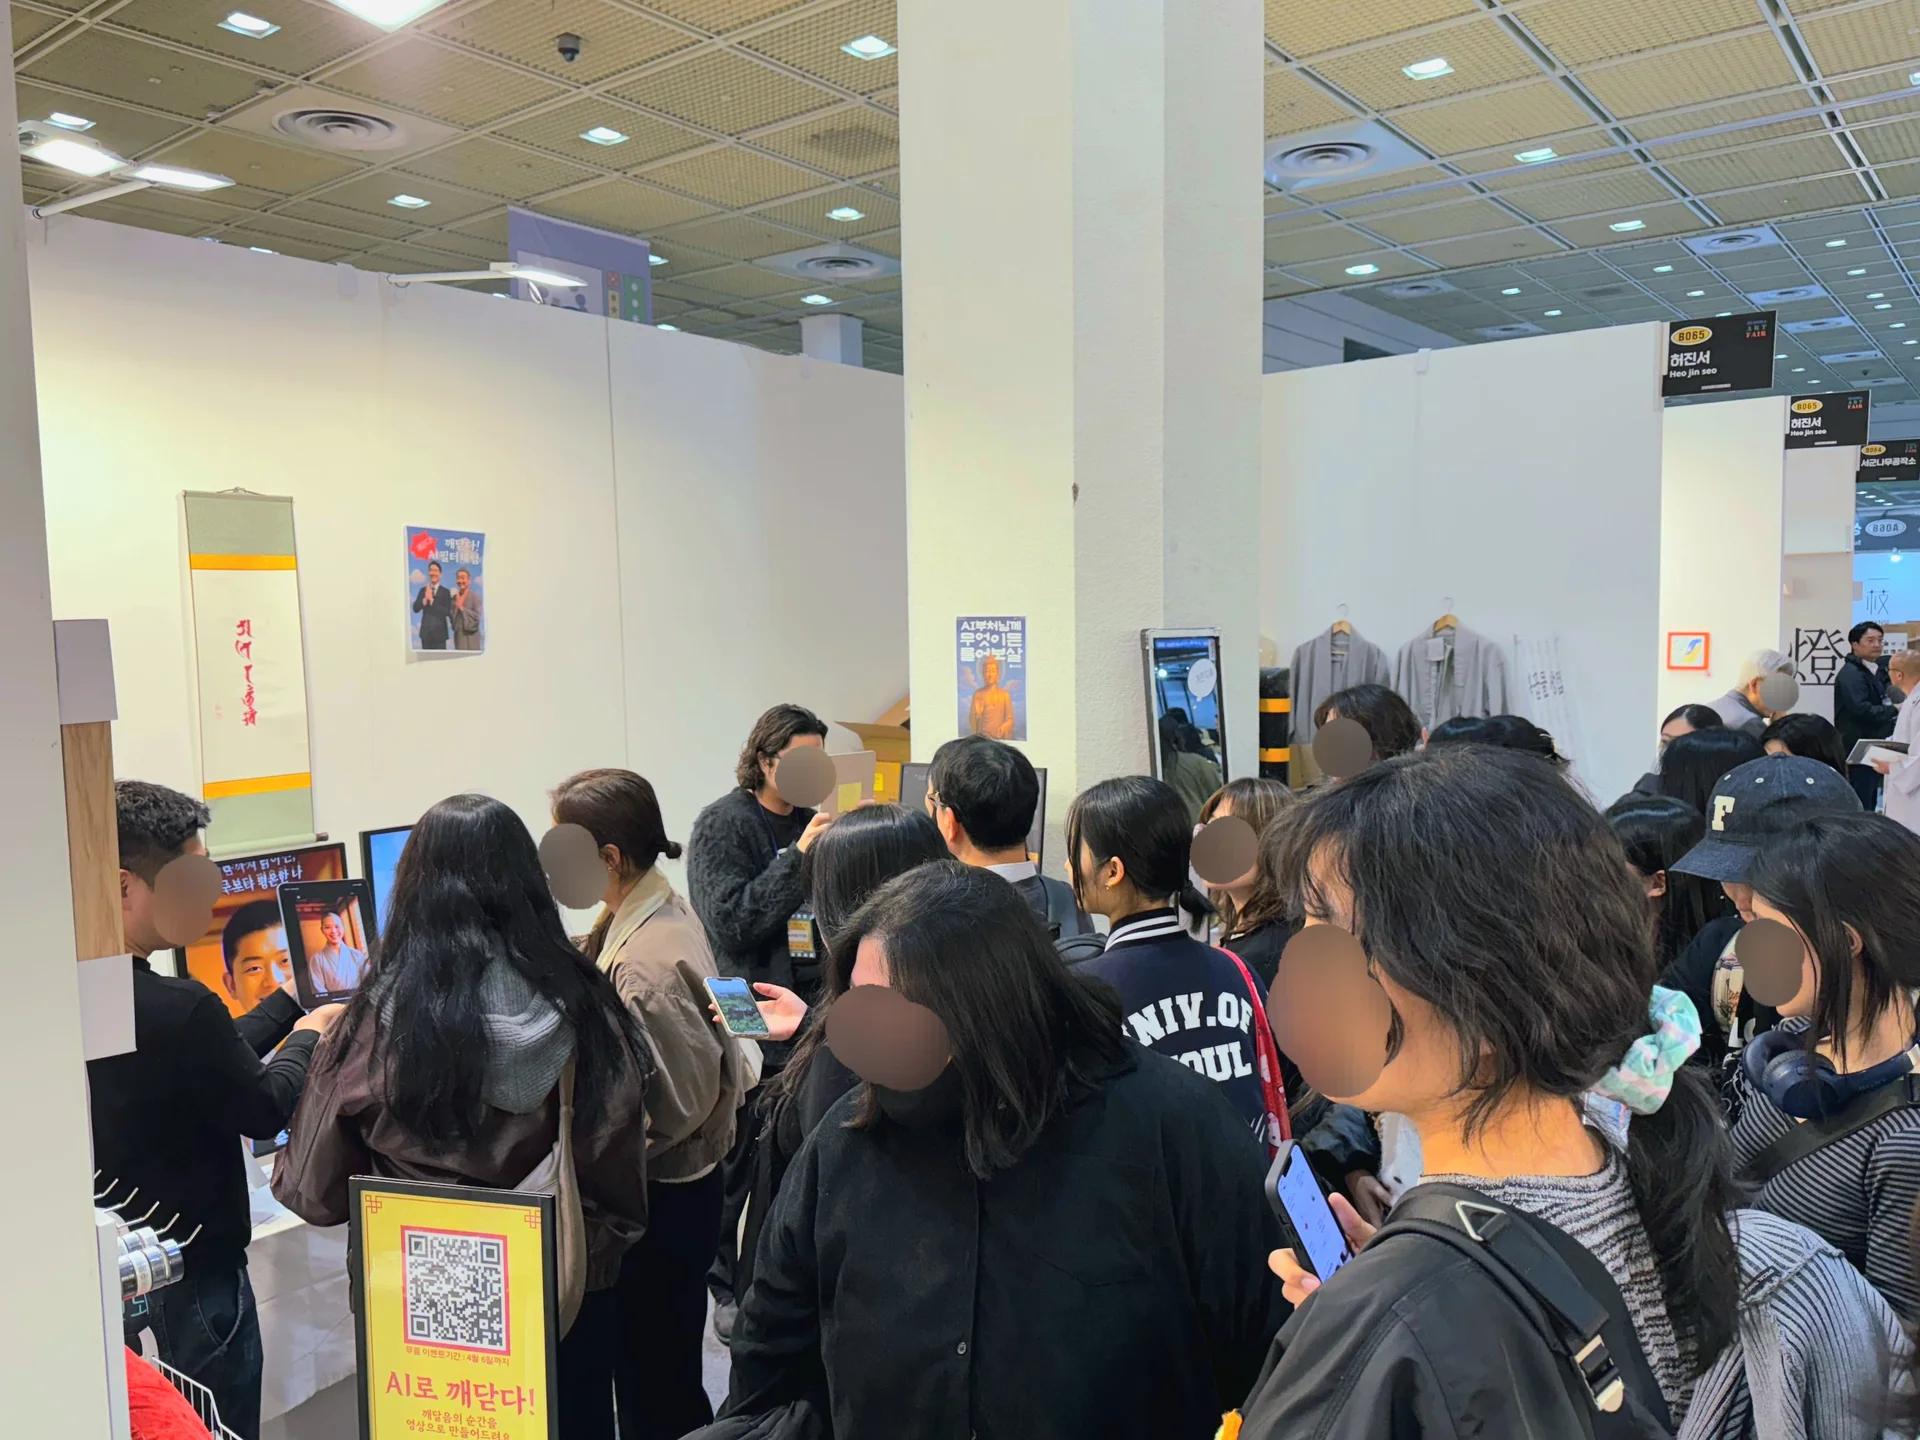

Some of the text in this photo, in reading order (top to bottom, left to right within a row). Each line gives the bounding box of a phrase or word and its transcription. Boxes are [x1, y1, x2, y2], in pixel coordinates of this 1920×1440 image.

[1678, 330, 1705, 341] B065
[1670, 350, 1711, 367] 허진서
[1669, 367, 1717, 378] Heo jin seo
[1796, 402, 1818, 410] B065
[1791, 417, 1822, 428] 허진서
[960, 620, 1022, 632] AI부처님께
[960, 632, 1022, 647] 무엇이든
[1712, 796, 1736, 831] F
[405, 1346, 421, 1356] 무료
[422, 1348, 461, 1361] 이벤트기간
[467, 1354, 479, 1363] 4월
[481, 1356, 510, 1367] 6일까지
[385, 1371, 535, 1416] AI로 깨닫다!
[406, 1418, 446, 1434] 영상으로
[422, 1409, 498, 1429] 깨달음의 순간을
